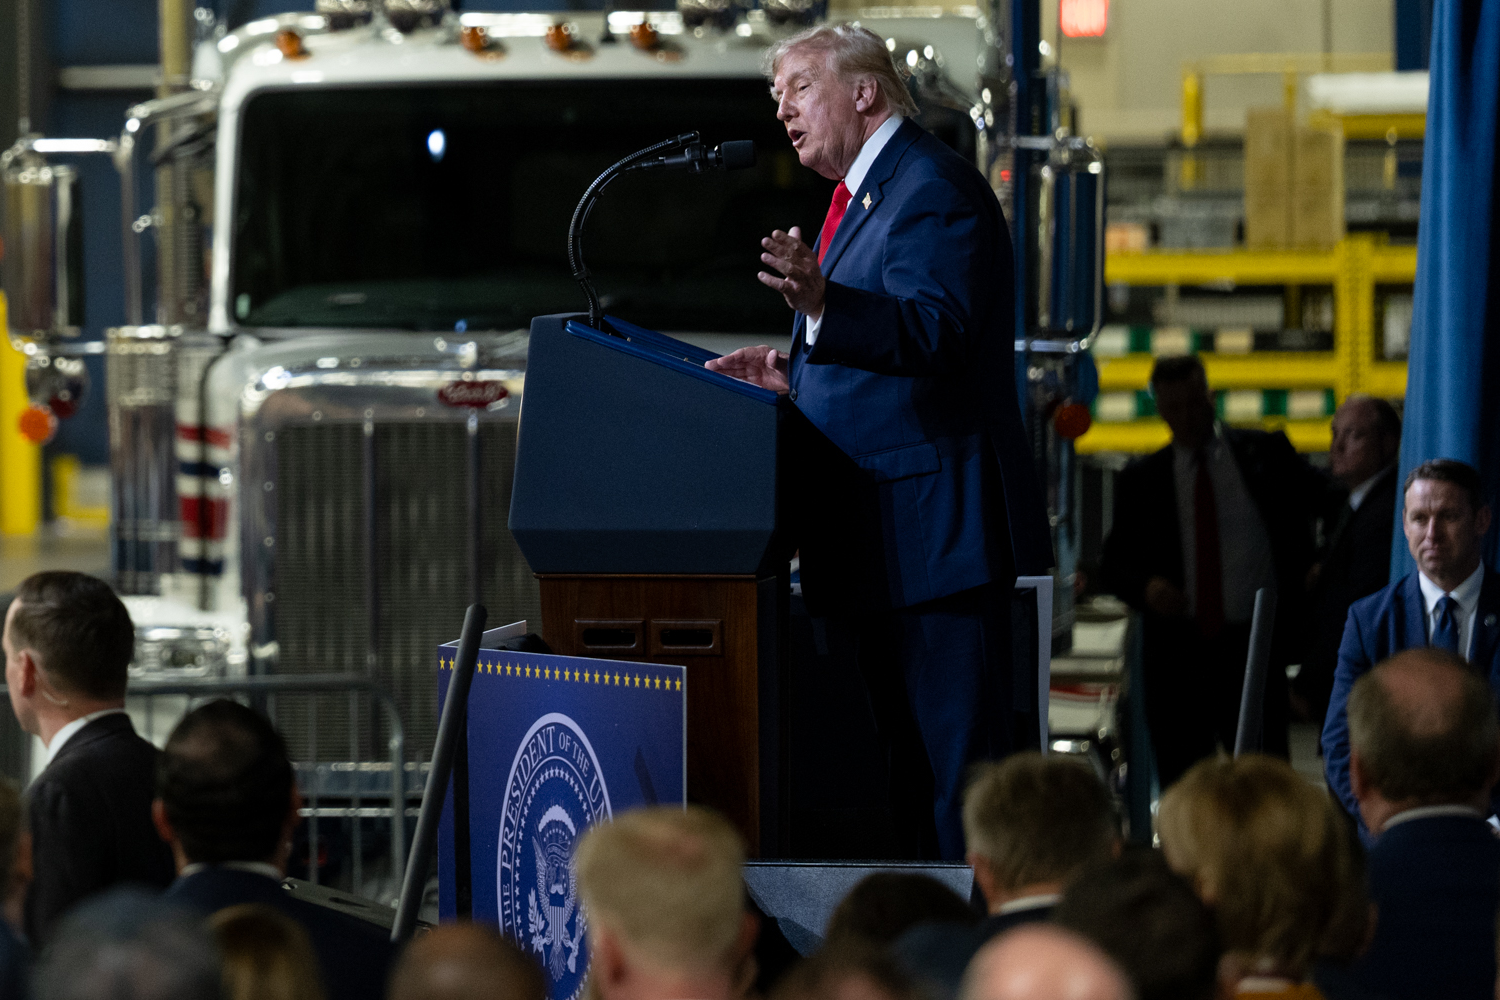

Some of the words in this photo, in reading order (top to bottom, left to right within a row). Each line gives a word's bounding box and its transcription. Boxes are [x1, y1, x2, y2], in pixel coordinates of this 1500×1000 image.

[558, 732, 572, 752] OF
[572, 741, 590, 777] THE
[501, 726, 555, 871] PRESIDENT
[502, 883, 512, 932] THE
